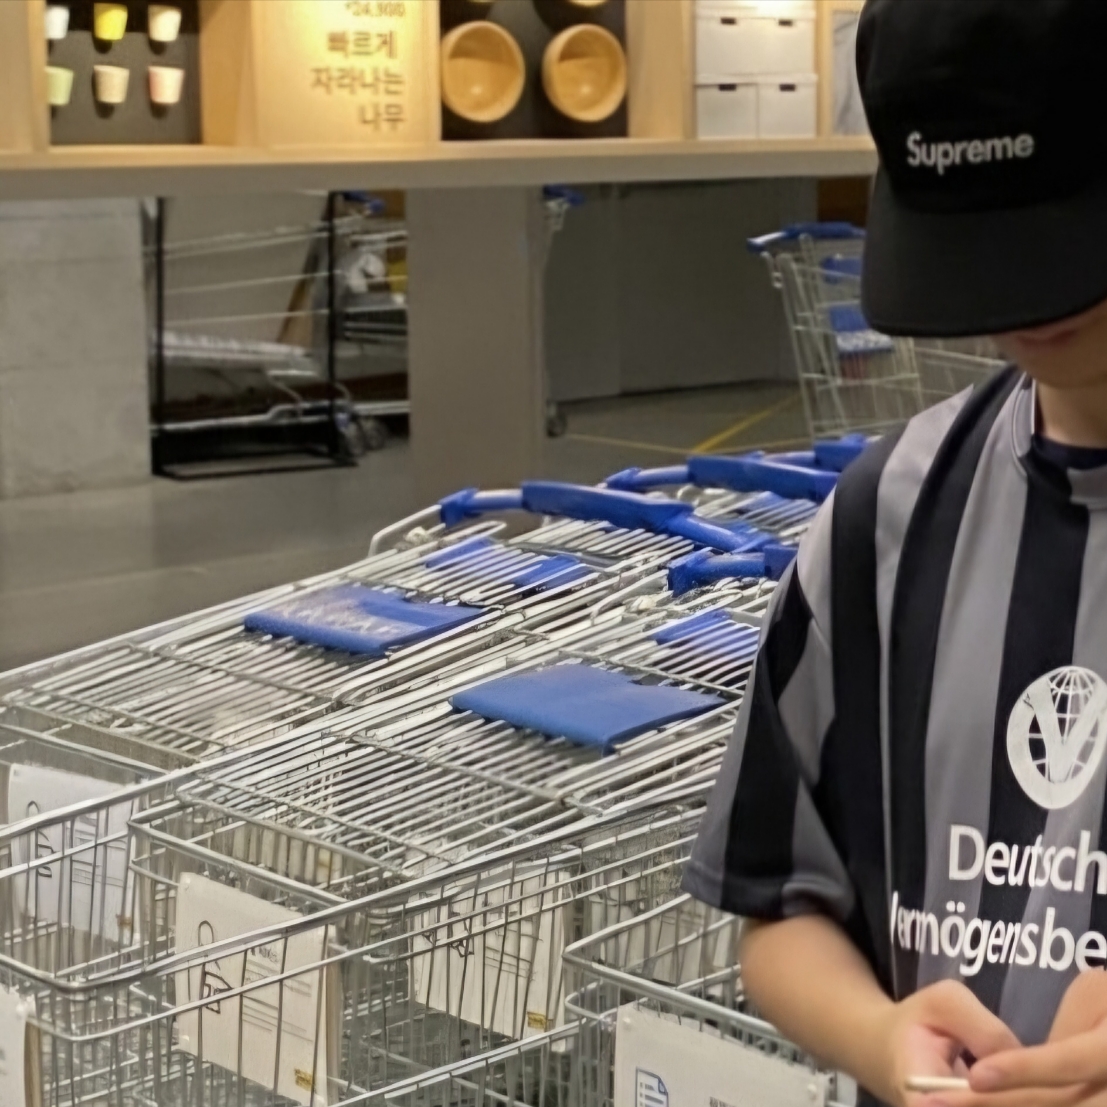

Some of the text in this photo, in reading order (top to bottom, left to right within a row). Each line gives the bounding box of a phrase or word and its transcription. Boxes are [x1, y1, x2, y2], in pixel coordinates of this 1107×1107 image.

[327, 30, 397, 59] 빠르게
[311, 67, 405, 96] 자라나는
[359, 103, 406, 131] 나무
[906, 131, 1035, 176] Supreme
